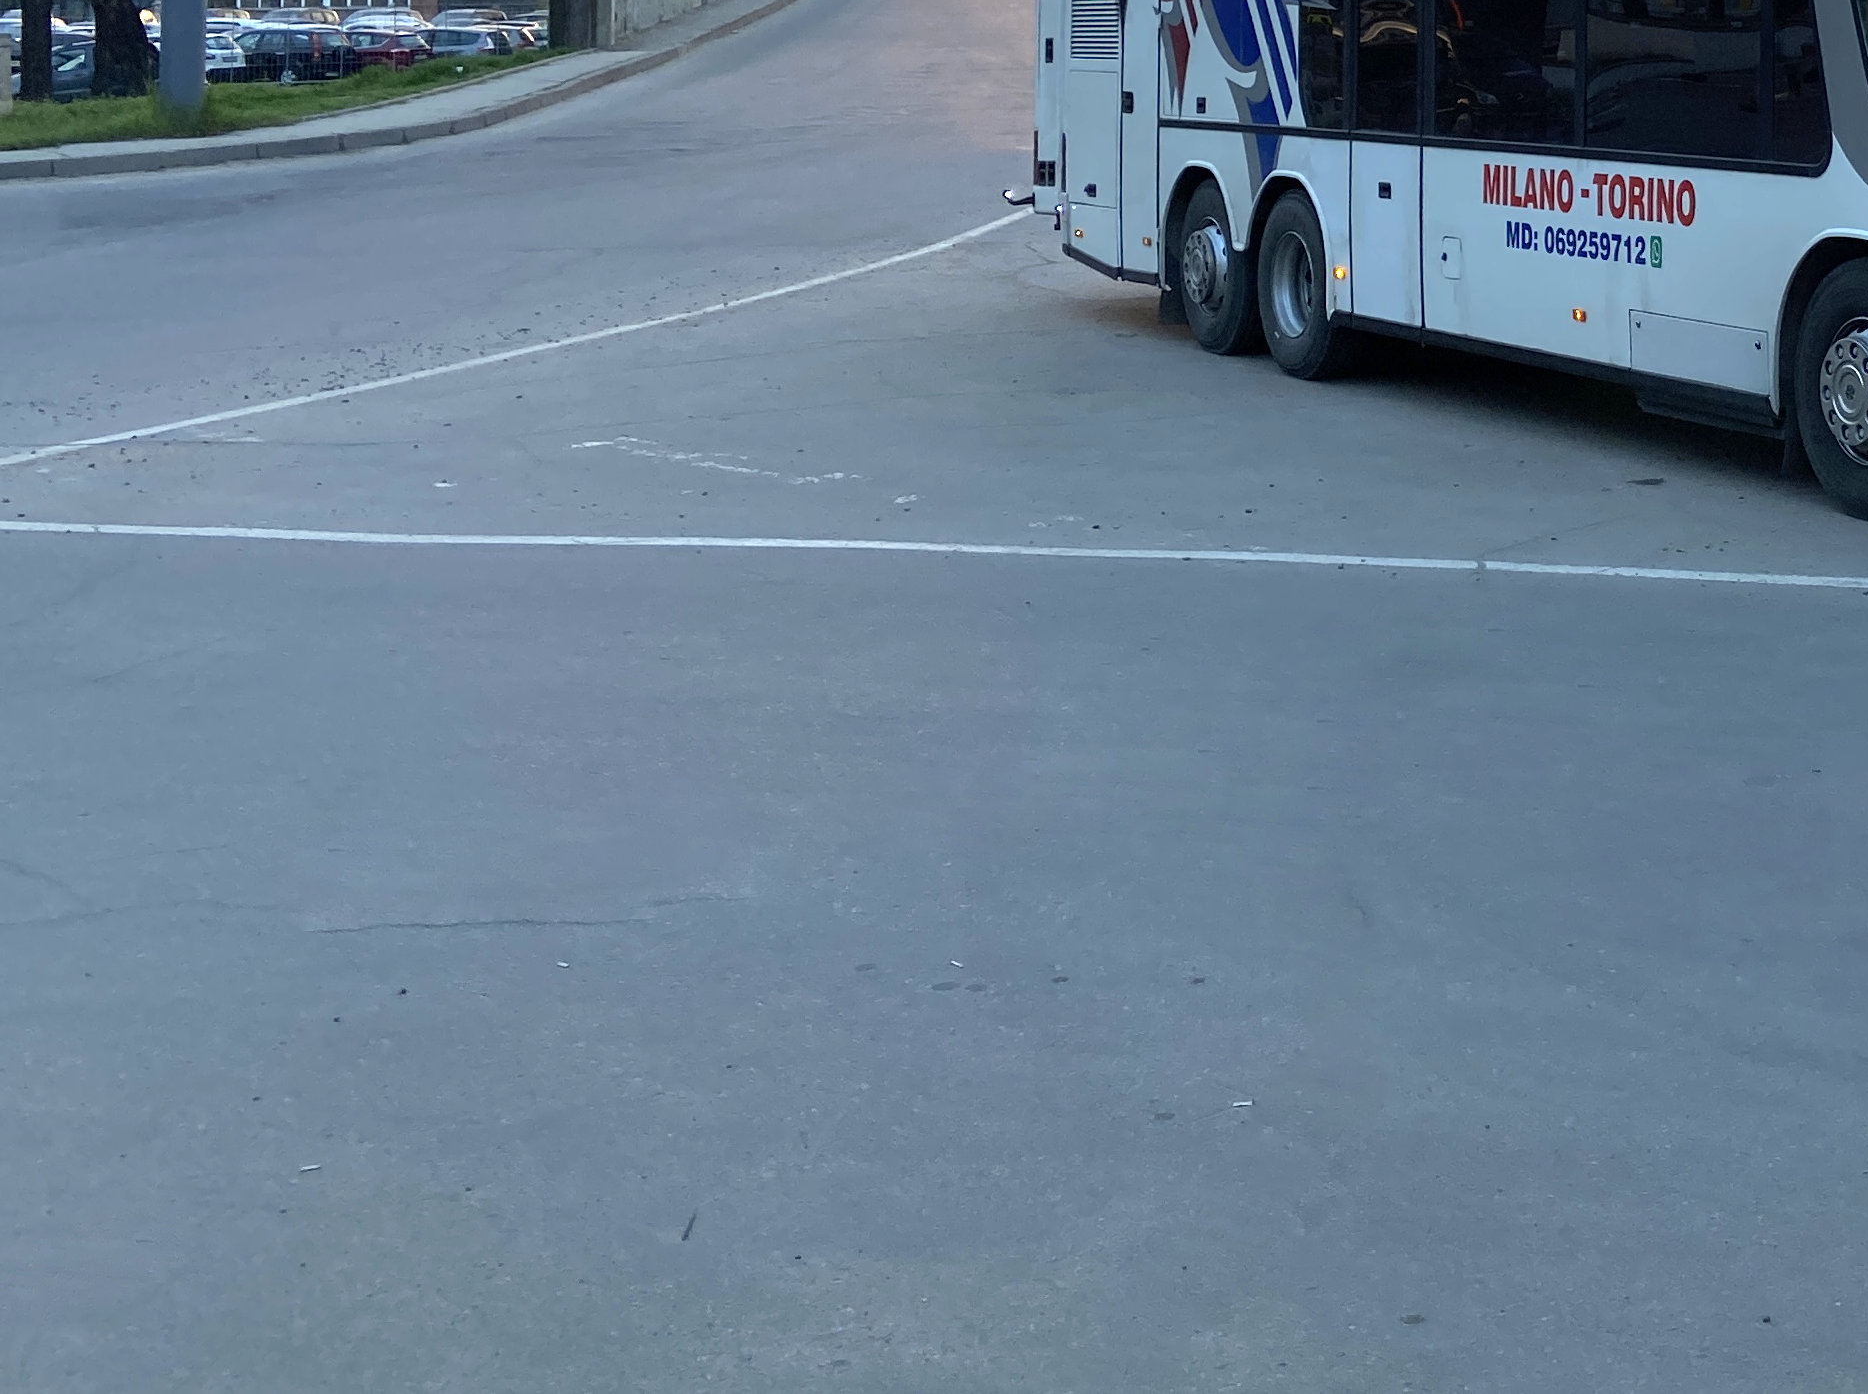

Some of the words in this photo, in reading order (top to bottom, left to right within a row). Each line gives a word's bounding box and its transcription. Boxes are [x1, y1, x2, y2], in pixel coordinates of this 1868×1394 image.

[1483, 163, 1574, 213] MILANO
[1592, 172, 1696, 227] TORINO
[1506, 221, 1538, 251] MD:
[1544, 225, 1647, 266] 069259712
